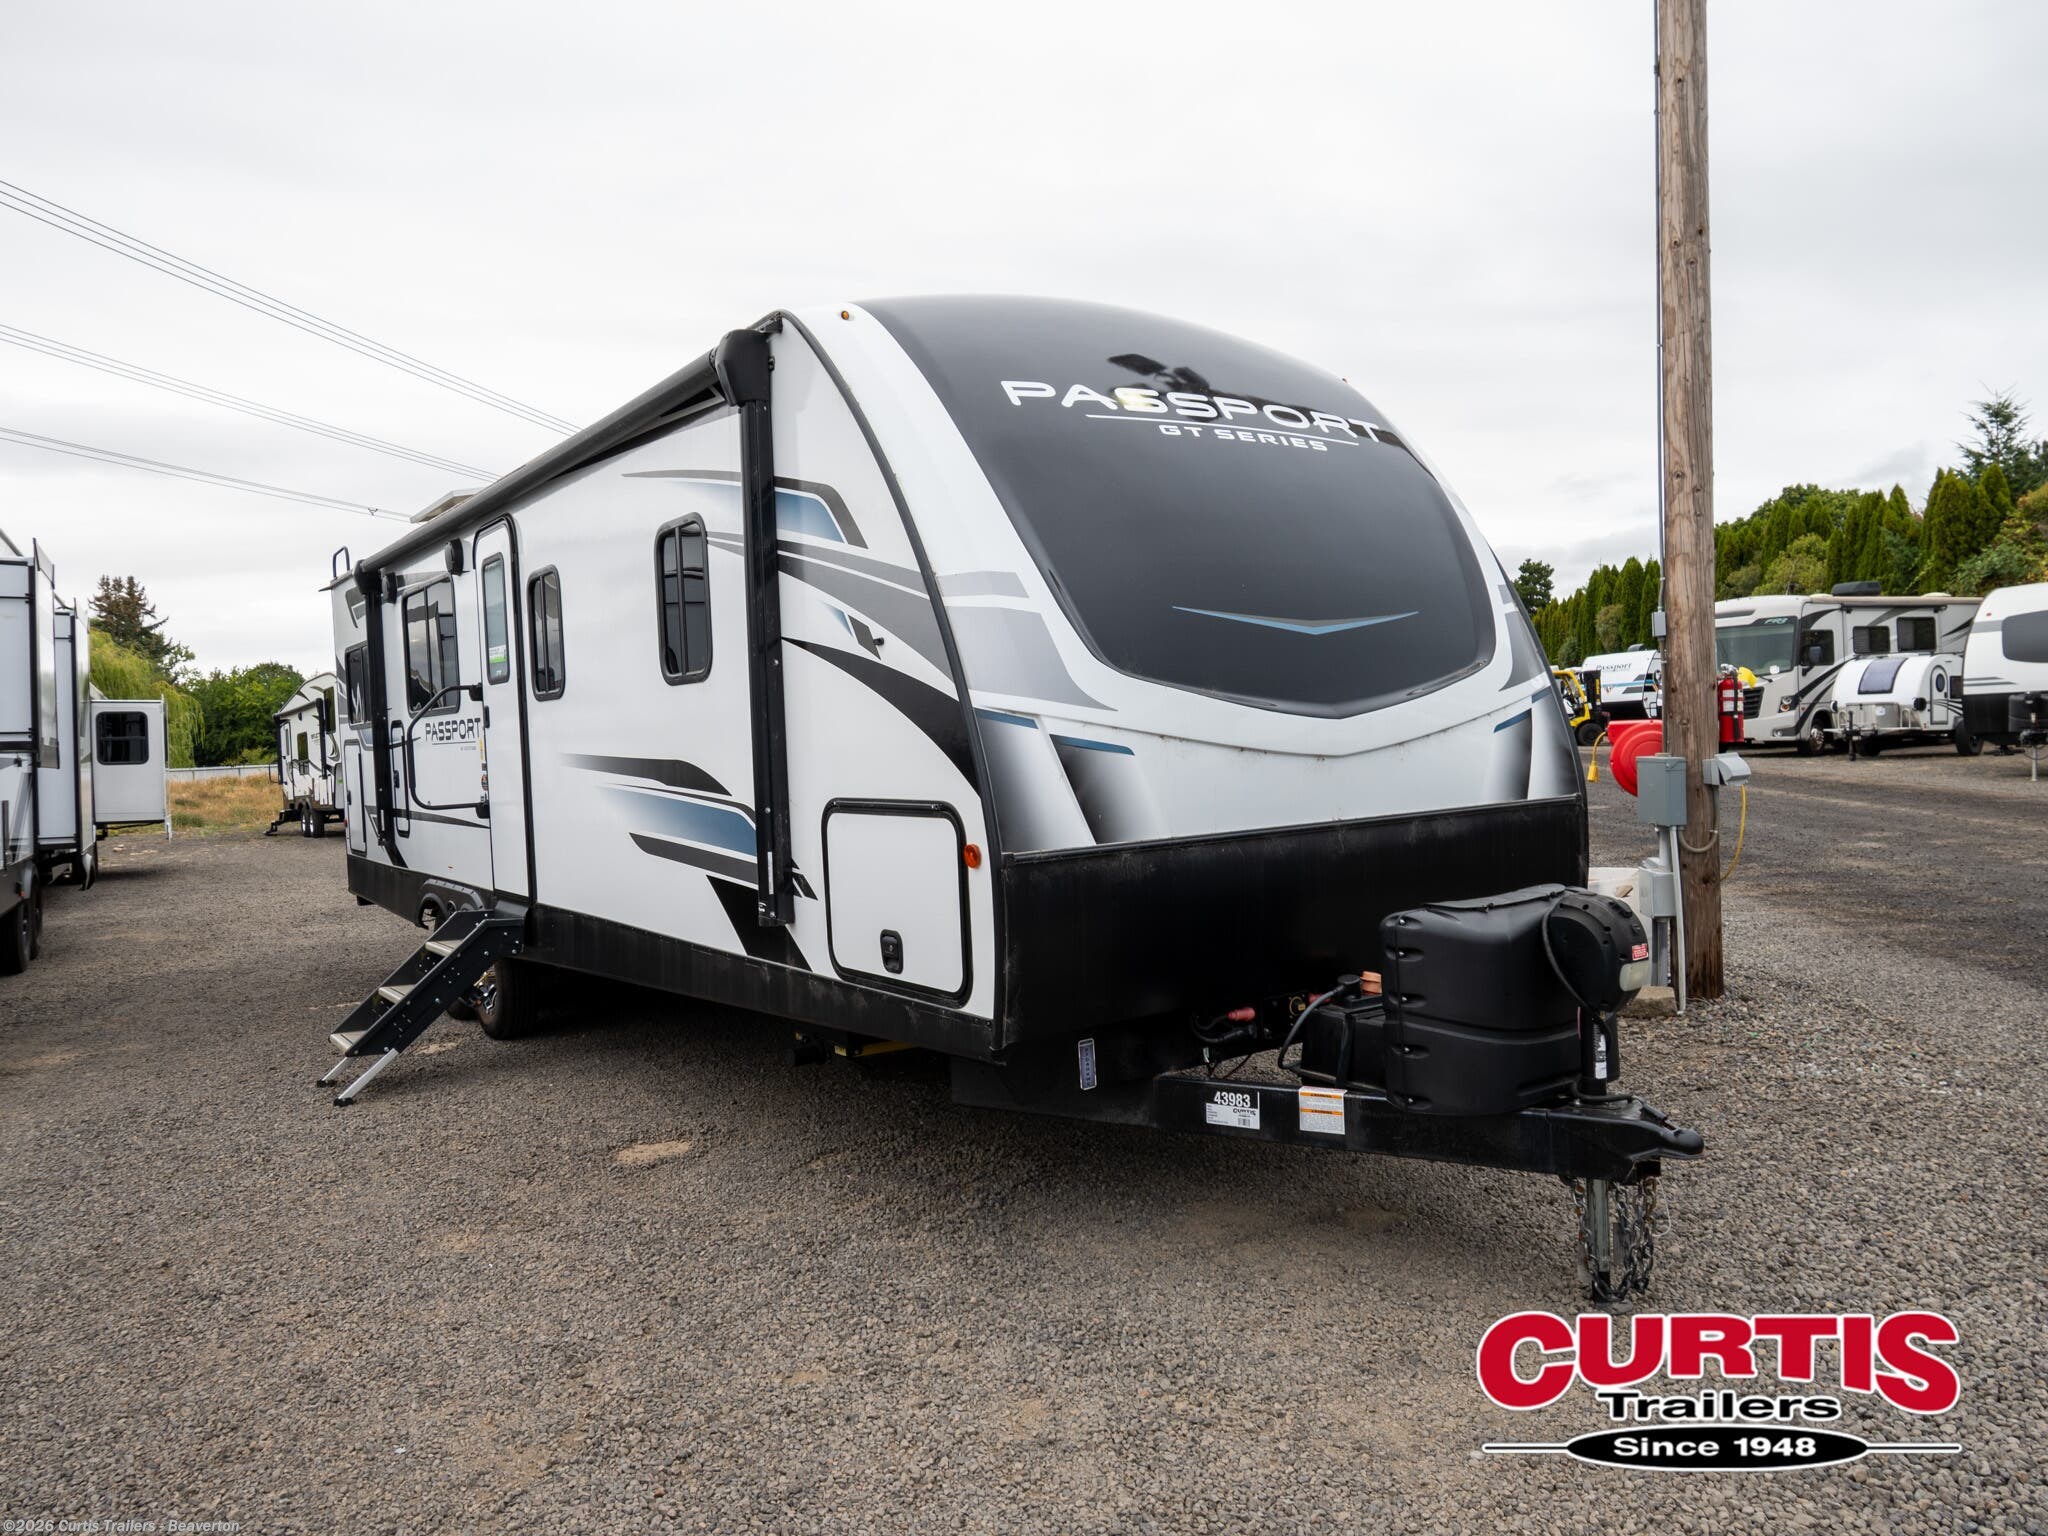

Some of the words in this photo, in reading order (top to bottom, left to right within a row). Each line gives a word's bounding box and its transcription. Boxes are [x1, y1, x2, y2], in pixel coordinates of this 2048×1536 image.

[1000, 380, 1380, 443] PASSPORT
[1159, 424, 1202, 438] GT
[1214, 428, 1329, 452] SERIES
[425, 717, 481, 742] PASSPORT
[1213, 1091, 1251, 1108] 43983
